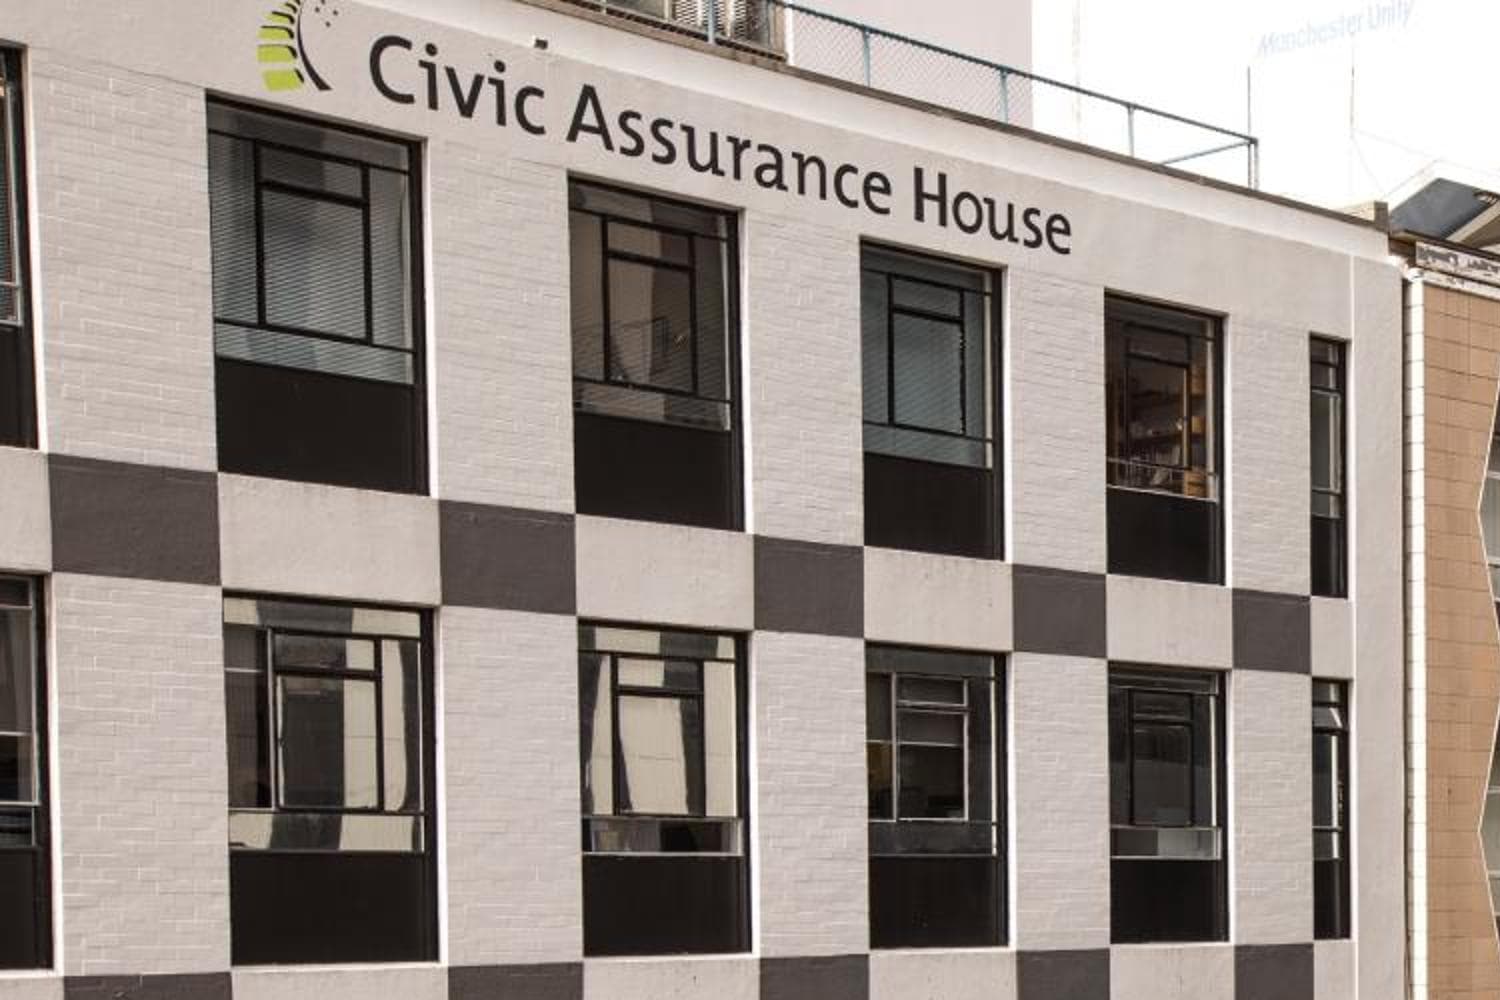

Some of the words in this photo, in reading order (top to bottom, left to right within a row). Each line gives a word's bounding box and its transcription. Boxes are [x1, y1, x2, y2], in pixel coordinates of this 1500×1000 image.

[1256, 12, 1362, 58] Manchester
[1366, 0, 1415, 31] Unity
[369, 35, 545, 135] Civic
[566, 84, 892, 215] Assurance
[914, 167, 1073, 255] House
